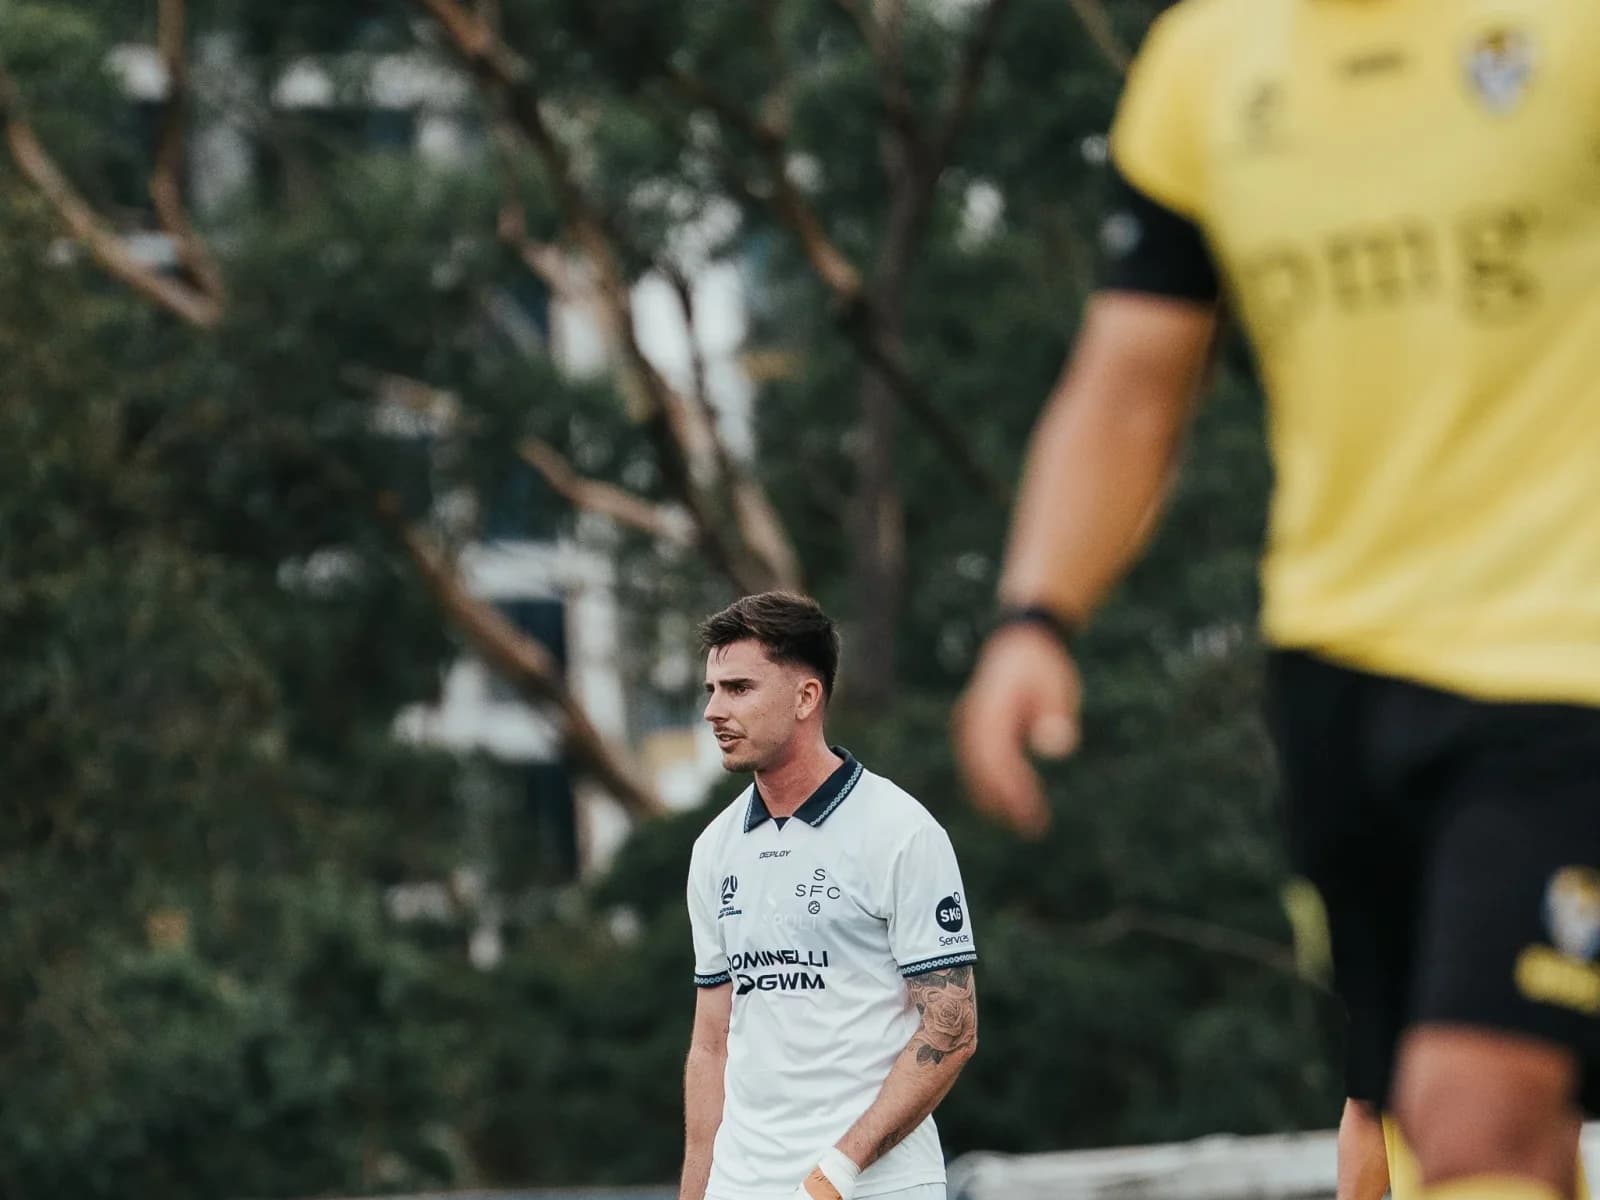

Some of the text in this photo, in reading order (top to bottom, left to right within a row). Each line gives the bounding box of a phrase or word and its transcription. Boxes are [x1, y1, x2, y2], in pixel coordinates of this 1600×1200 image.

[759, 849, 792, 860] DEPLOY
[813, 868, 826, 881] S
[940, 903, 962, 923] SKG
[757, 972, 826, 991] GWM
